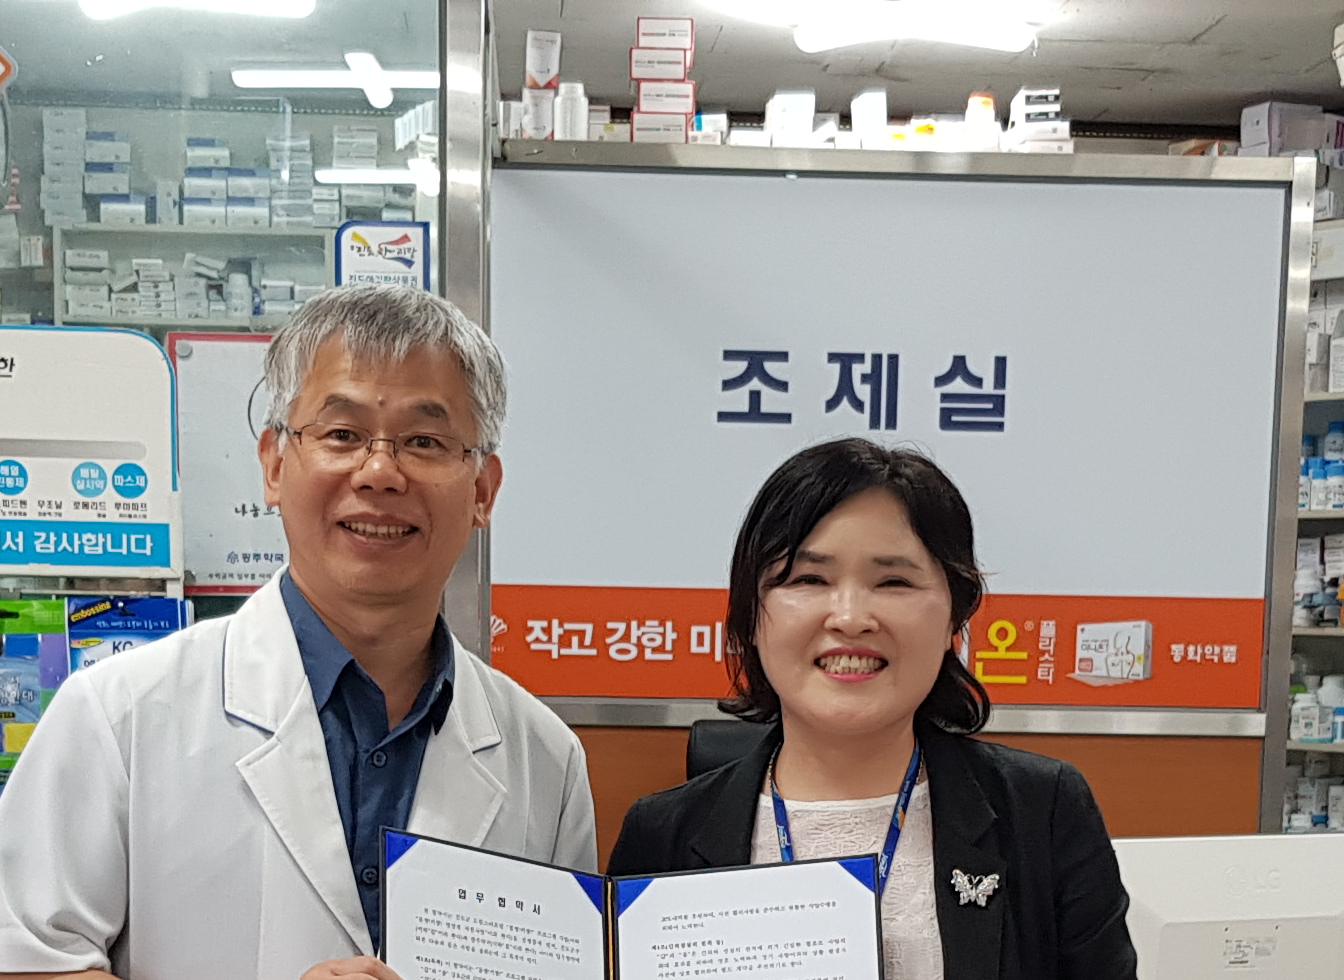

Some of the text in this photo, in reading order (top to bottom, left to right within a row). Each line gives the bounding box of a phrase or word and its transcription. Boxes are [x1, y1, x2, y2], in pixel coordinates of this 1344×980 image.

[114, 474, 146, 487] 파스제
[34, 531, 153, 558] 감사합니다
[525, 618, 597, 660] 작고
[604, 620, 677, 662] 강한
[974, 618, 1029, 686] 온
[1170, 642, 1238, 665] 동화약품
[1257, 866, 1282, 892] LG
